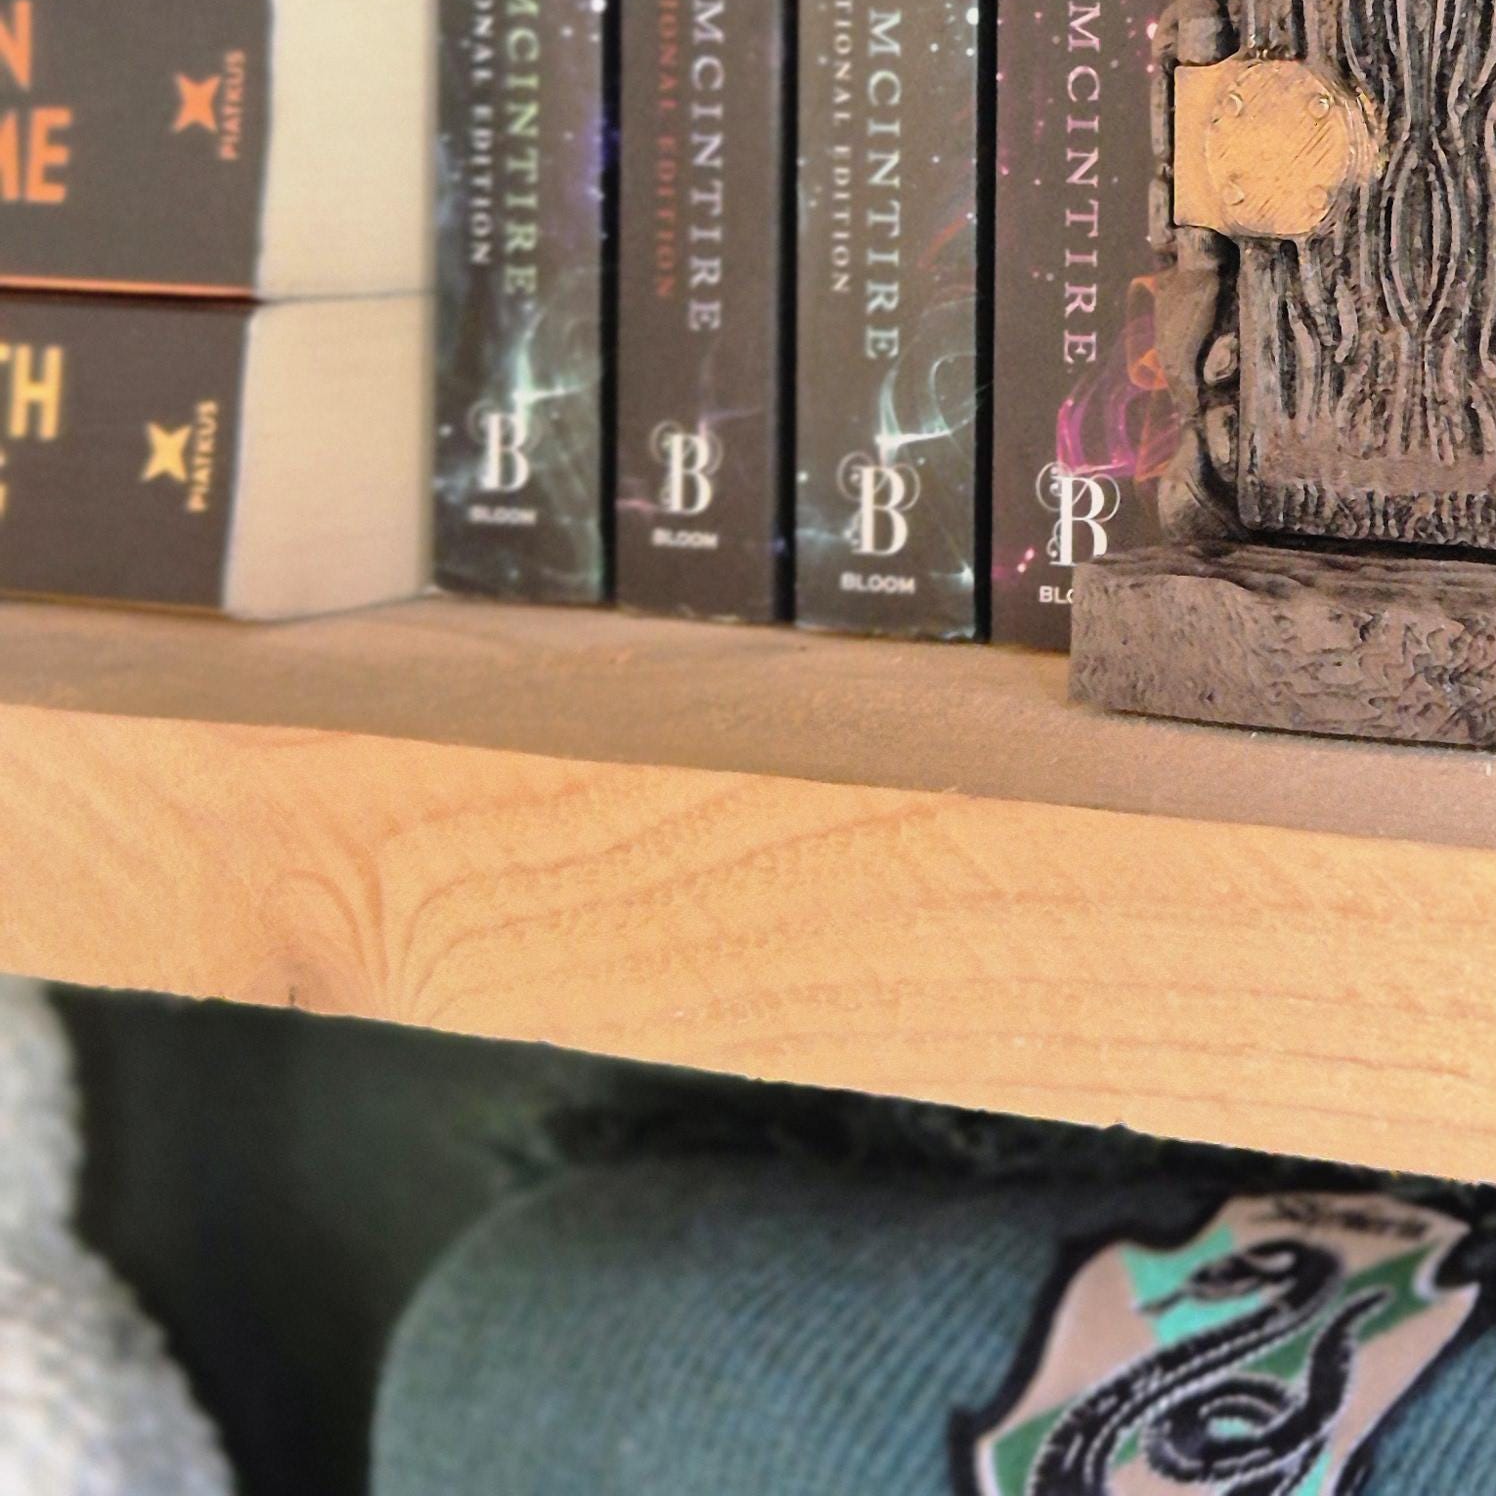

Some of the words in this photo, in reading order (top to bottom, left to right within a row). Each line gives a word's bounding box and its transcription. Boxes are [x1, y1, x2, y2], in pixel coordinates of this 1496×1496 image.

[219, 50, 246, 160] PIATKUS
[689, 0, 724, 331] MCINTIRE
[471, 106, 493, 265] EDITION
[656, 136, 677, 298] EDITION
[830, 145, 851, 294] EDITION
[865, 10, 901, 360] MCINTIRE
[1063, 2, 1100, 364] MCINTIRE
[187, 401, 218, 512] PIATKUS
[468, 505, 537, 525] BLOOM
[653, 527, 718, 549] BLOOM
[840, 571, 916, 594] BLOOM
